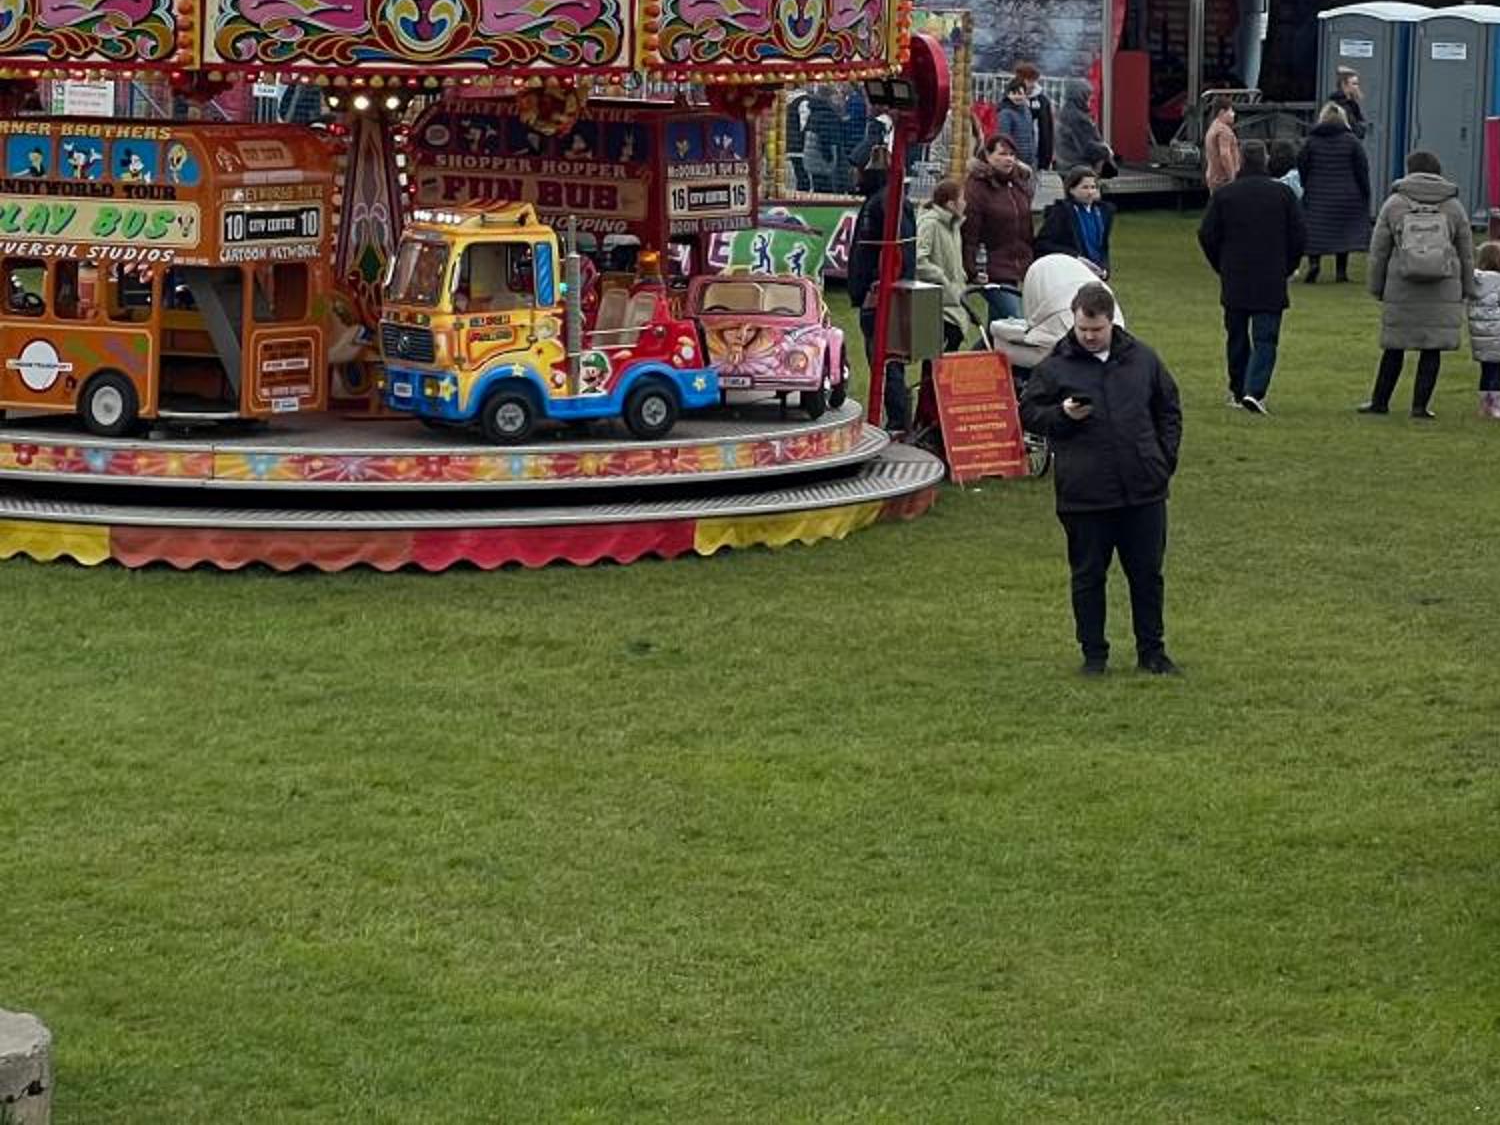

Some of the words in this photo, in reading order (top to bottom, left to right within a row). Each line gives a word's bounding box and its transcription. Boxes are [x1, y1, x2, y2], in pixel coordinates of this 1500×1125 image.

[61, 124, 172, 140] BROTHERS
[435, 155, 531, 173] SHOPPER
[542, 158, 626, 178] HOPPER
[123, 184, 177, 200] TOUR
[672, 188, 686, 211] 16
[732, 185, 746, 206] 16
[0, 203, 77, 235] LAY
[225, 215, 243, 240] 10
[249, 219, 266, 232] CITY
[267, 217, 296, 232] CENTRE
[301, 210, 318, 235] 10
[0, 241, 77, 259] VERSAL
[86, 246, 175, 262] STUDIOS
